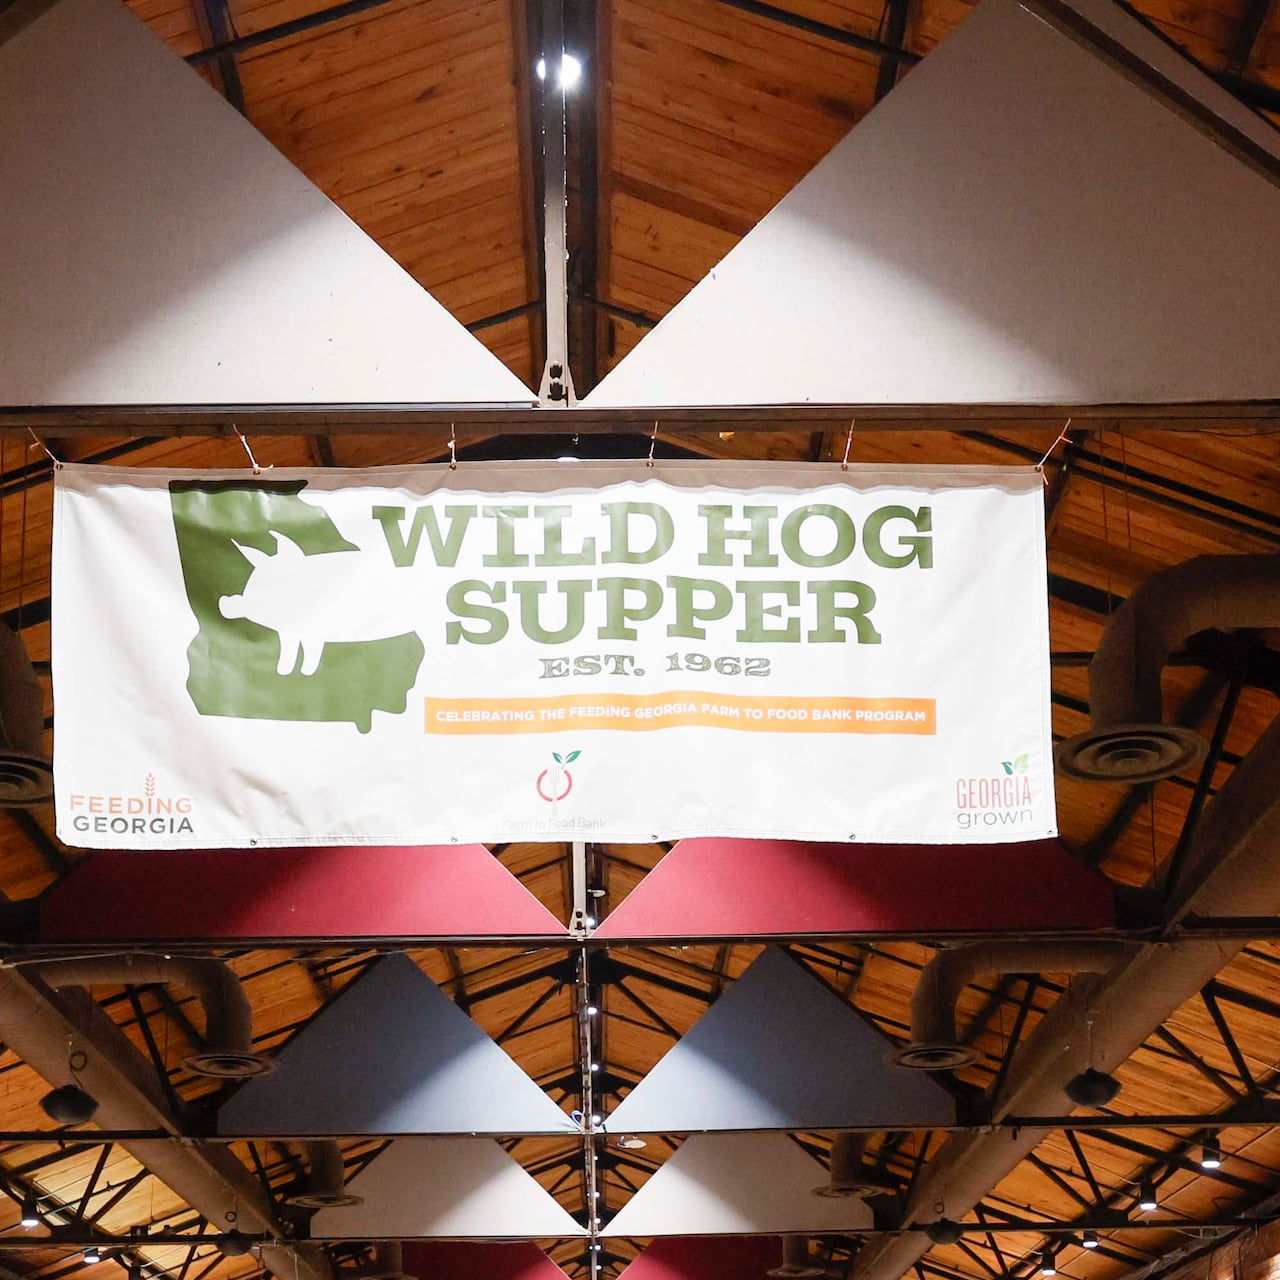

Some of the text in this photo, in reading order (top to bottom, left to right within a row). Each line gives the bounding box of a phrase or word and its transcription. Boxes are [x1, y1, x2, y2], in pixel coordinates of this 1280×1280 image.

[372, 502, 933, 568] WILD HOG
[446, 575, 881, 644] SUPPER
[539, 652, 771, 678] EST. 1962
[436, 704, 926, 722] CELEBRATING THE FEEDING GEORGIA FARM TO FOOD BANK PROGRAM
[957, 776, 1032, 808] GEORGIA
[70, 795, 192, 814] FEEDING
[73, 816, 194, 834] GEORGIA
[548, 818, 575, 829] Food
[577, 817, 607, 829] Bank
[957, 809, 1033, 829] grown
